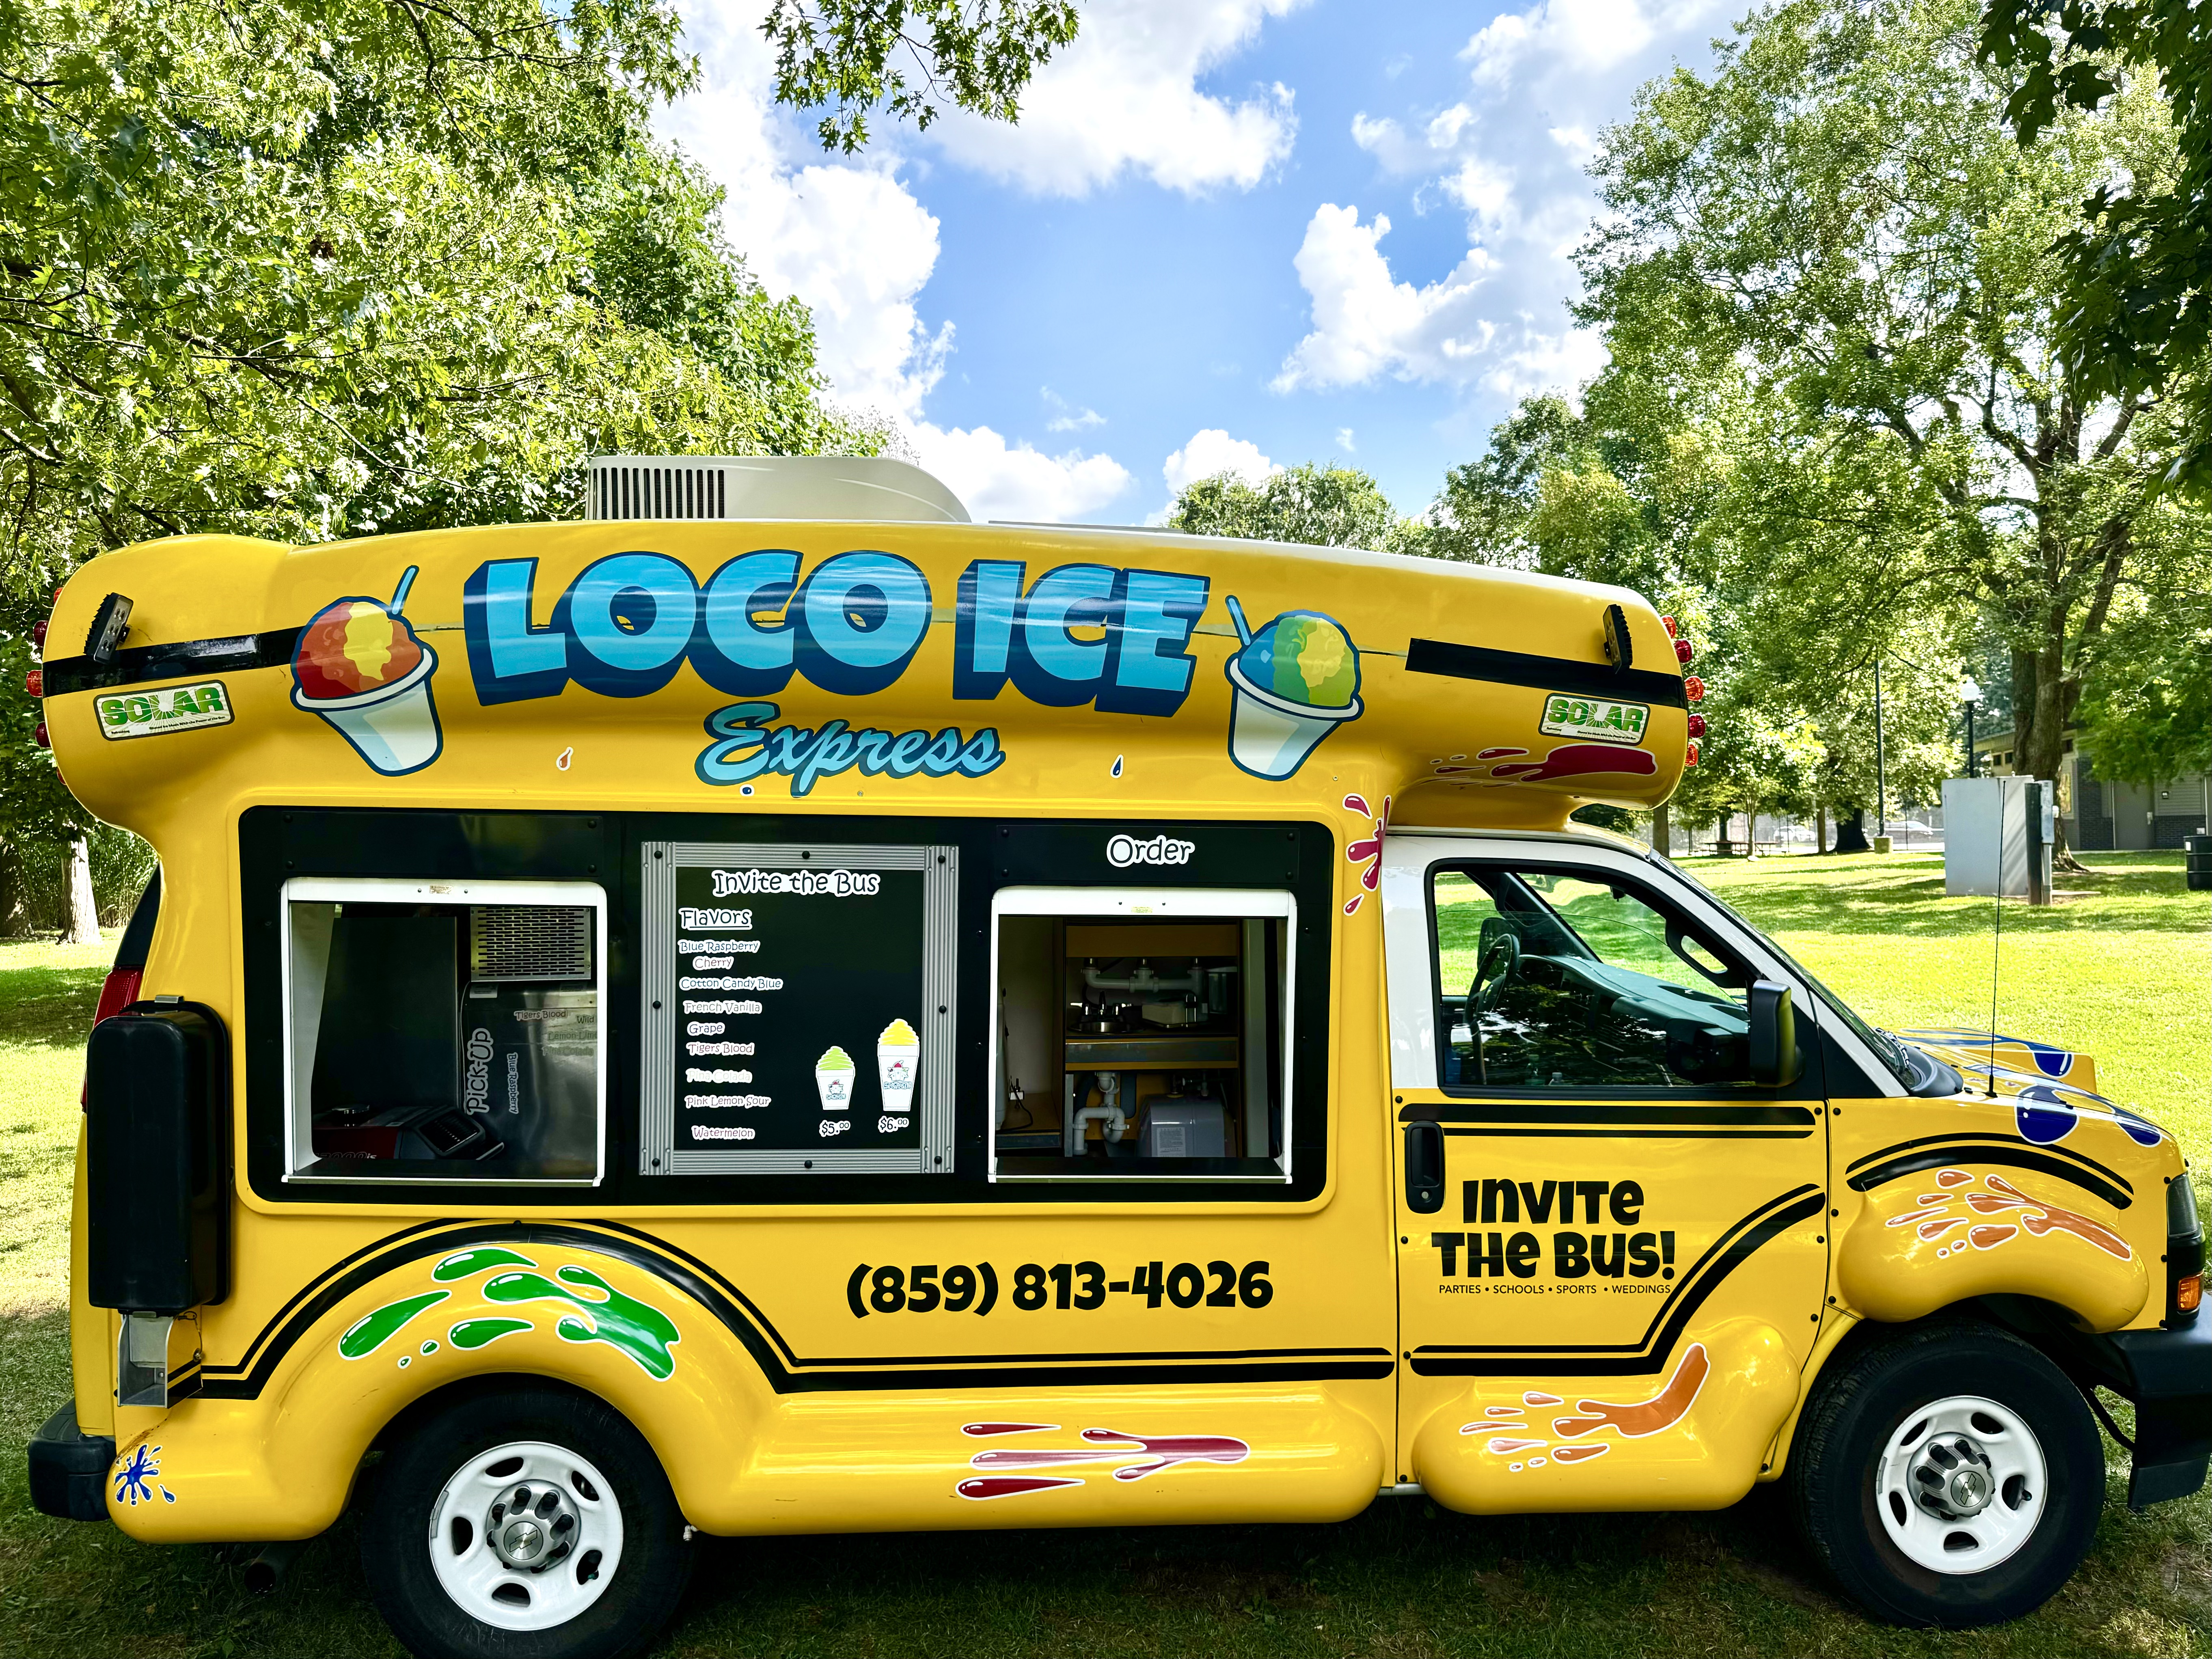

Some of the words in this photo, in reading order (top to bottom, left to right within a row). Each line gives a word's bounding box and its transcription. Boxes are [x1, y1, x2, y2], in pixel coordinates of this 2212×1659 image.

[464, 549, 932, 706] LOCO
[953, 559, 1210, 717] ICE
[101, 687, 224, 725] SOLAR
[1548, 699, 1643, 732] SOLAR
[695, 701, 1006, 798] Express
[1109, 837, 1191, 864] Order
[714, 872, 782, 894] Invite
[789, 872, 828, 893] the
[835, 872, 878, 894] Bus
[681, 910, 749, 927] Flavors
[680, 941, 704, 951] Blue
[706, 941, 758, 952] Raspberry
[695, 958, 732, 969] Cherry
[681, 979, 719, 988] Cotton
[723, 979, 755, 988] Candy
[758, 979, 781, 988] Blue
[685, 1003, 722, 1012] French
[725, 1002, 760, 1012] Vanilla
[516, 1011, 540, 1020] Tigers
[577, 1016, 594, 1024] Wild
[689, 1024, 723, 1033] Grape
[688, 1044, 720, 1053] Tigers
[723, 1044, 752, 1053] Blood
[508, 1053, 517, 1072] Blue
[467, 1031, 491, 1112] Pick-Up
[688, 1070, 710, 1080] Pina
[714, 1071, 750, 1081] Colada
[509, 1072, 517, 1113] Raspberry
[686, 1097, 708, 1106] Pink
[711, 1097, 743, 1106] Lemon
[746, 1096, 769, 1106] Sour
[822, 1122, 849, 1135] $5.00
[880, 1117, 908, 1130] $6.00
[694, 1127, 753, 1137] Watermelon
[847, 1261, 999, 1319] (859)
[1013, 1260, 1273, 1311] 813-4026
[1439, 1284, 1481, 1294] PARTIES
[1493, 1284, 1544, 1294] SCHOOLS
[1556, 1284, 1597, 1294] SPORTS
[1612, 1284, 1671, 1294] WEDDINGS
